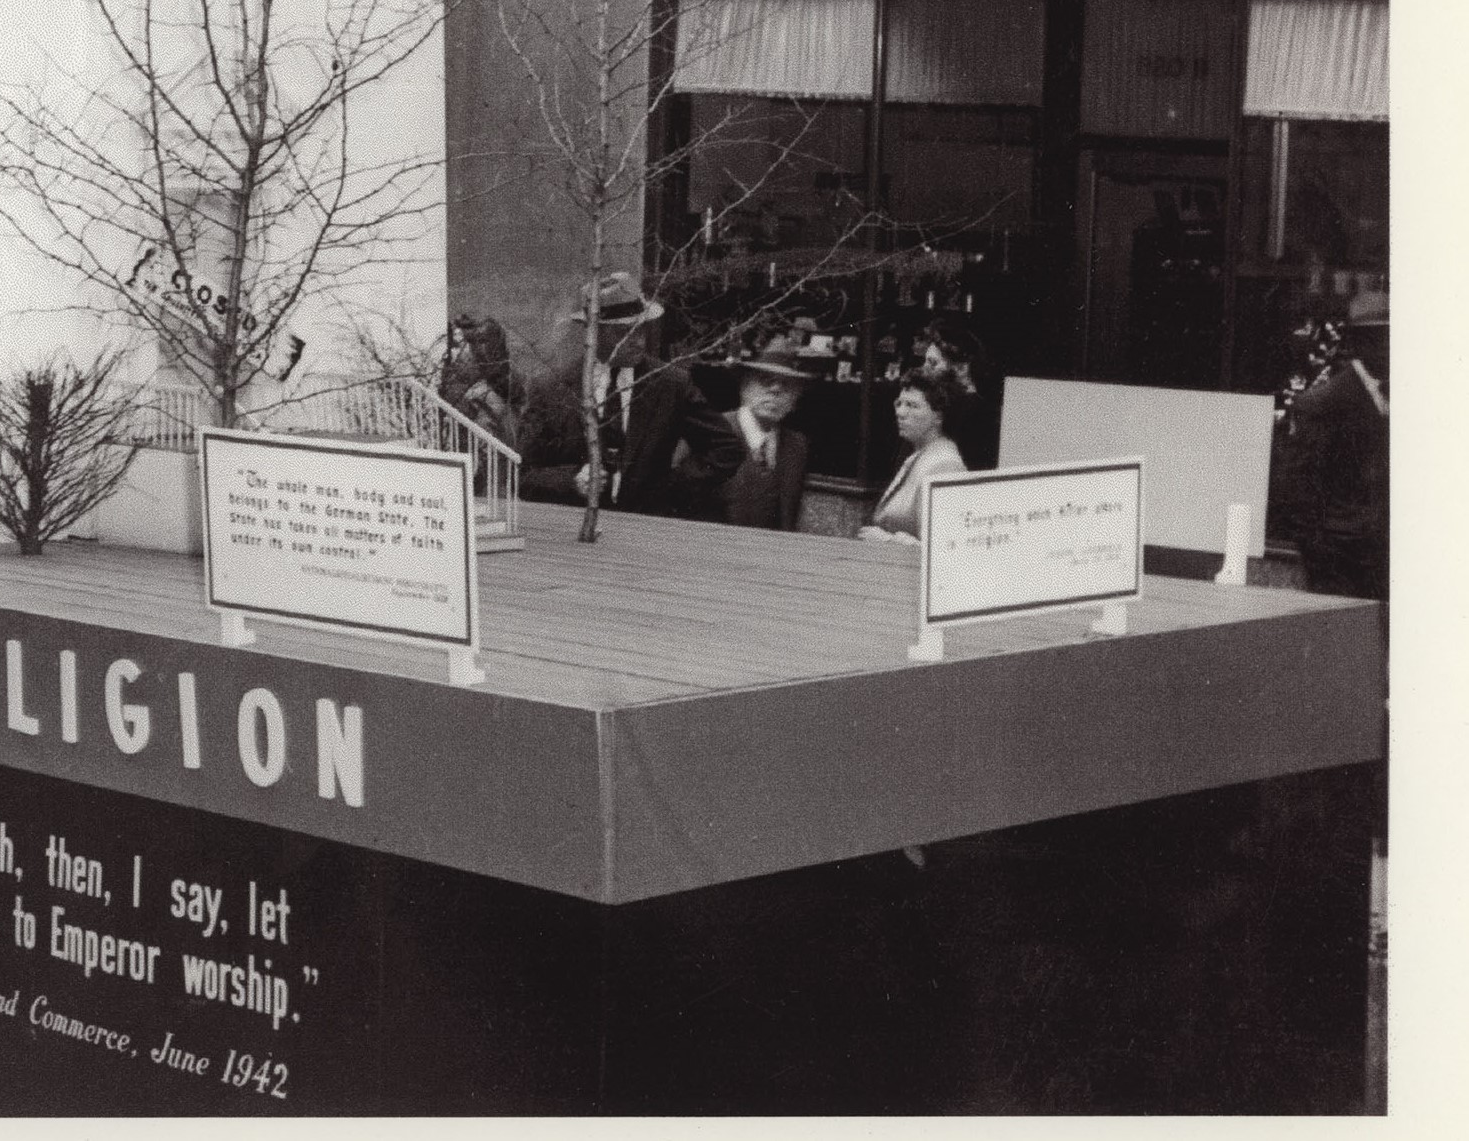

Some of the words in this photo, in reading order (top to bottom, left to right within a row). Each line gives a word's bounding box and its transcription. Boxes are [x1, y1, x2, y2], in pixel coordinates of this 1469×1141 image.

[325, 504, 370, 522] German
[424, 515, 445, 531] The
[354, 487, 385, 507] body
[45, 834, 111, 907] then,
[133, 855, 141, 908] I
[170, 878, 228, 938] say,
[249, 880, 291, 945] let
[14, 895, 36, 950] to
[51, 905, 161, 984] Emperor
[30, 994, 138, 1058] Commerce,
[150, 1032, 210, 1076] June
[221, 1048, 289, 1100] 1942
